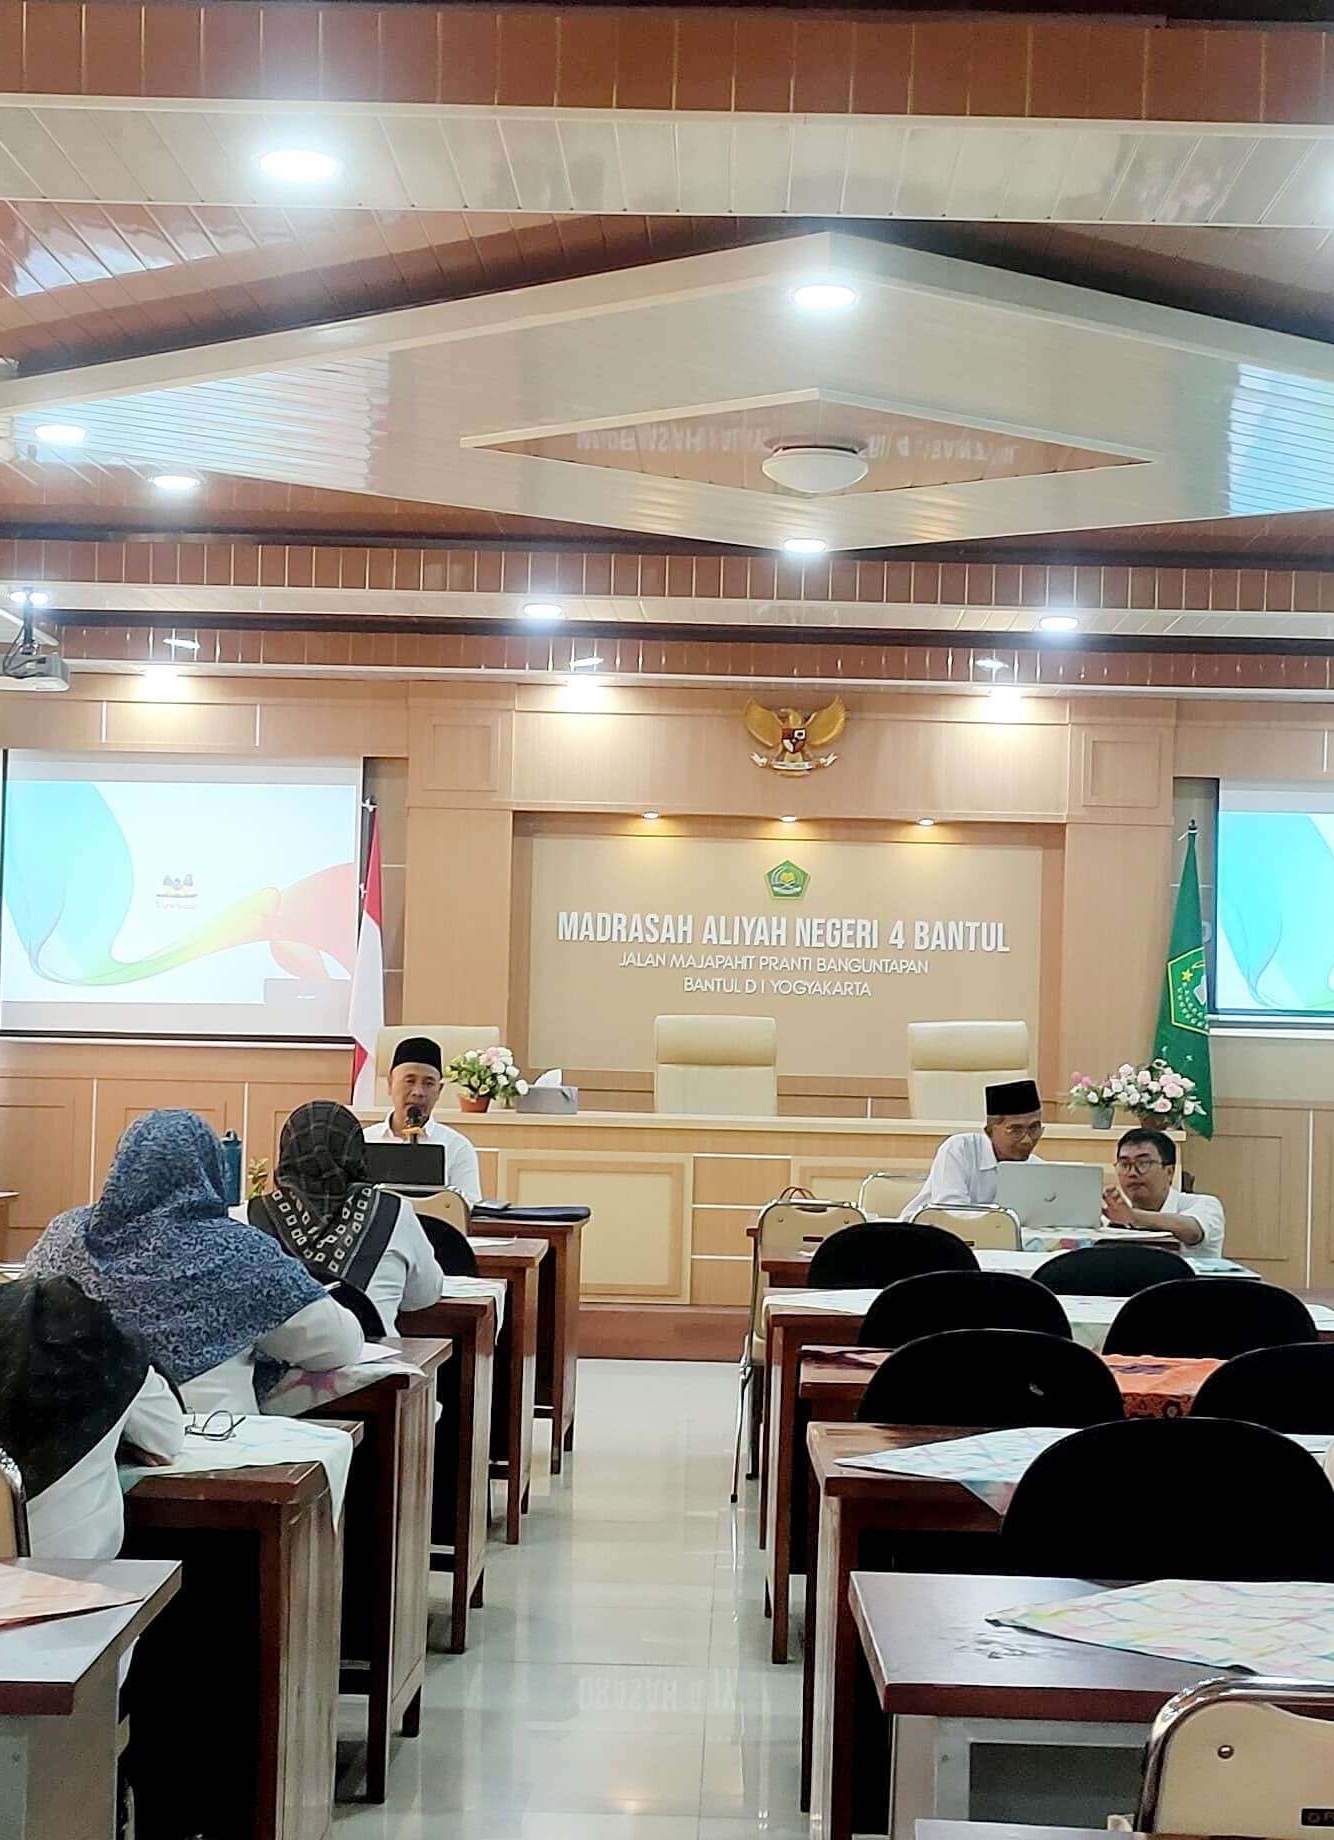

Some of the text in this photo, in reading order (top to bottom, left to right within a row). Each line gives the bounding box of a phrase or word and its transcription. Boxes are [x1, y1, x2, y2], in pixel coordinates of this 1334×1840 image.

[558, 911, 1010, 952] MADRASAH ALIYAH NEGERI 4 BANTUL
[619, 951, 928, 974] JALAN MAJAPAHIT PRANTI BANGUNTAPAN
[683, 976, 740, 993] BANTUL
[745, 979, 756, 994] D
[771, 979, 872, 997] YOGYAKARTA
